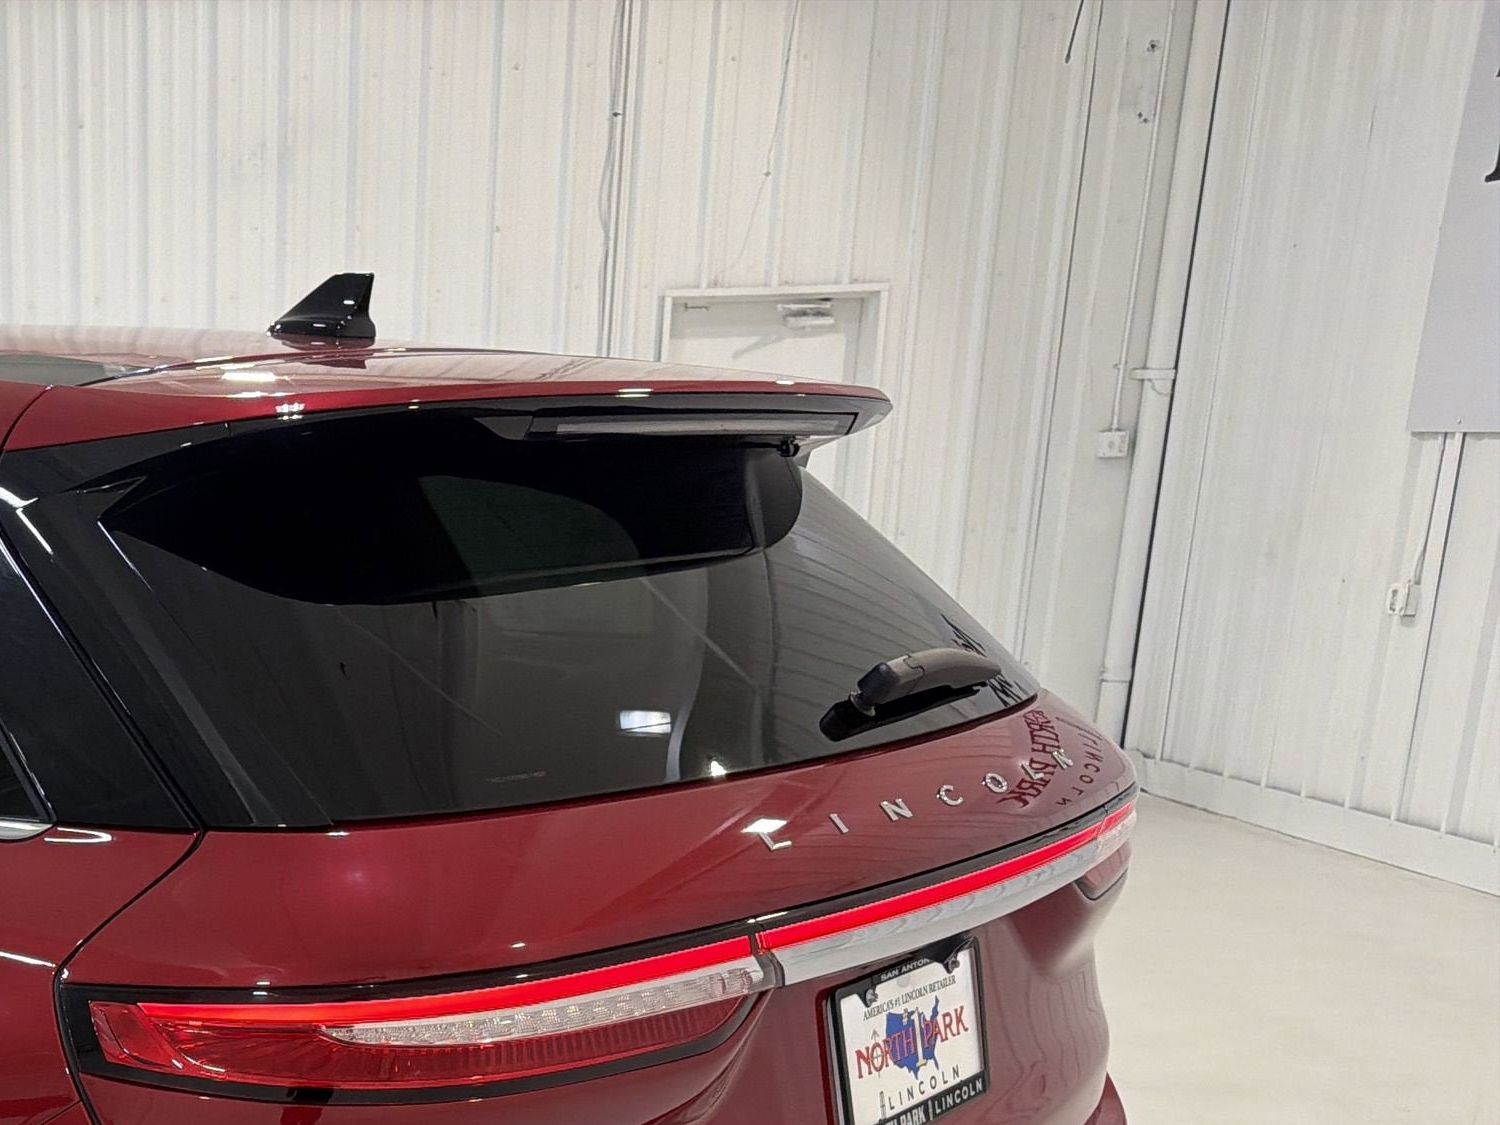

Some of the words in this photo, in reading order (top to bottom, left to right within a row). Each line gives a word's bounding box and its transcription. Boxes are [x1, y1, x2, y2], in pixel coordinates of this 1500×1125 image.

[758, 748, 1075, 852] LINCOLN
[880, 968, 900, 981] SAN
[901, 985, 928, 1005] LINCOLN
[855, 1026, 917, 1079] NORTH
[922, 1005, 969, 1048] PARK
[888, 1064, 960, 1110] LINCOLN
[935, 1078, 983, 1115] LINCOLN
